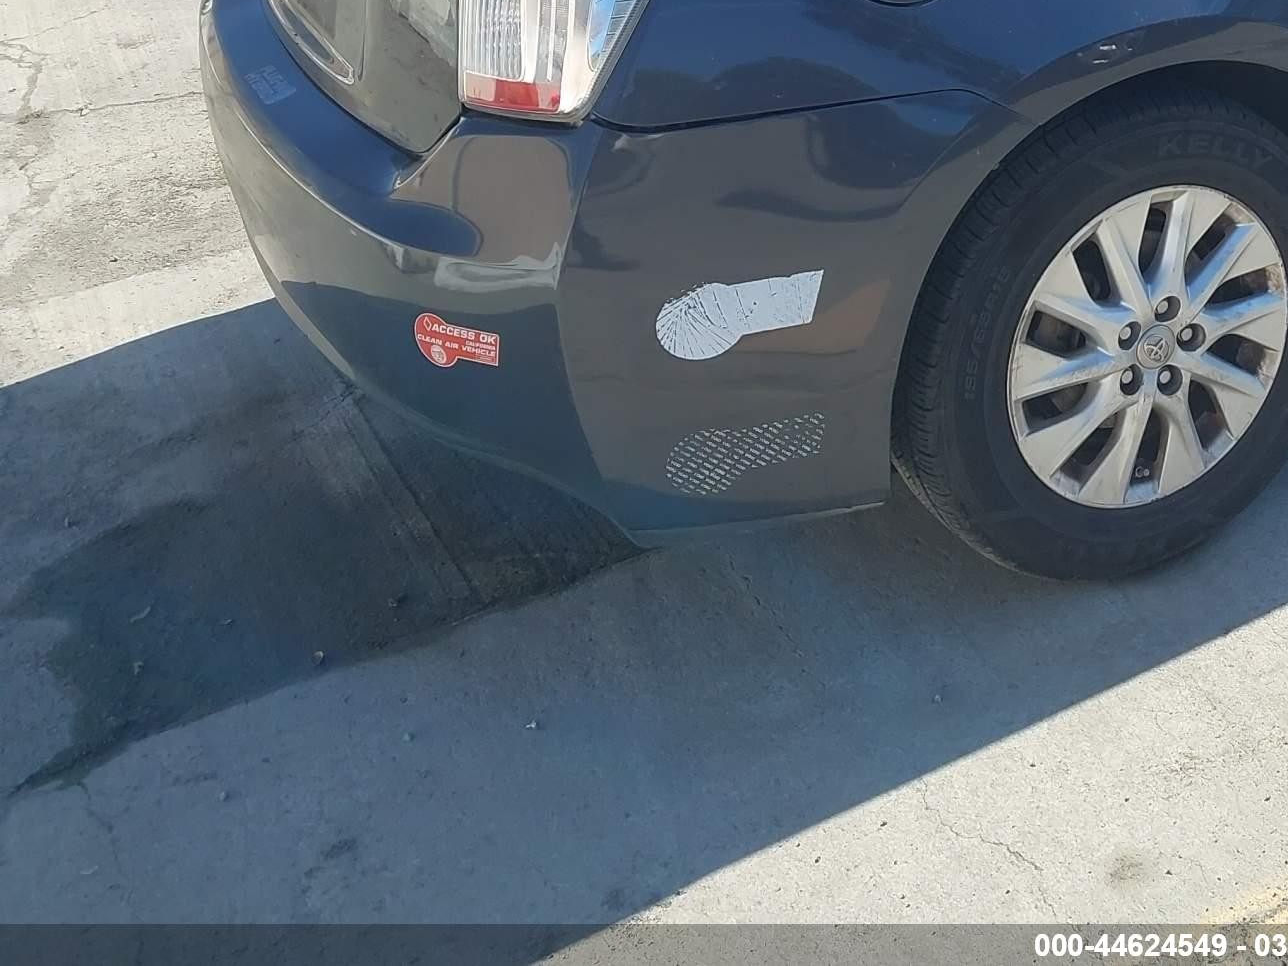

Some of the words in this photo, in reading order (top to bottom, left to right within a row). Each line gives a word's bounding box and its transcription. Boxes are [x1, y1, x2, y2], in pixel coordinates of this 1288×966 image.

[1158, 133, 1273, 170] KELLY
[417, 333, 443, 346] CLEAN
[444, 341, 459, 350] AIR
[461, 344, 497, 356] VEHICLE
[431, 323, 476, 340] ACCESS
[479, 334, 497, 345] OK
[465, 340, 496, 351] CALIFORNIA
